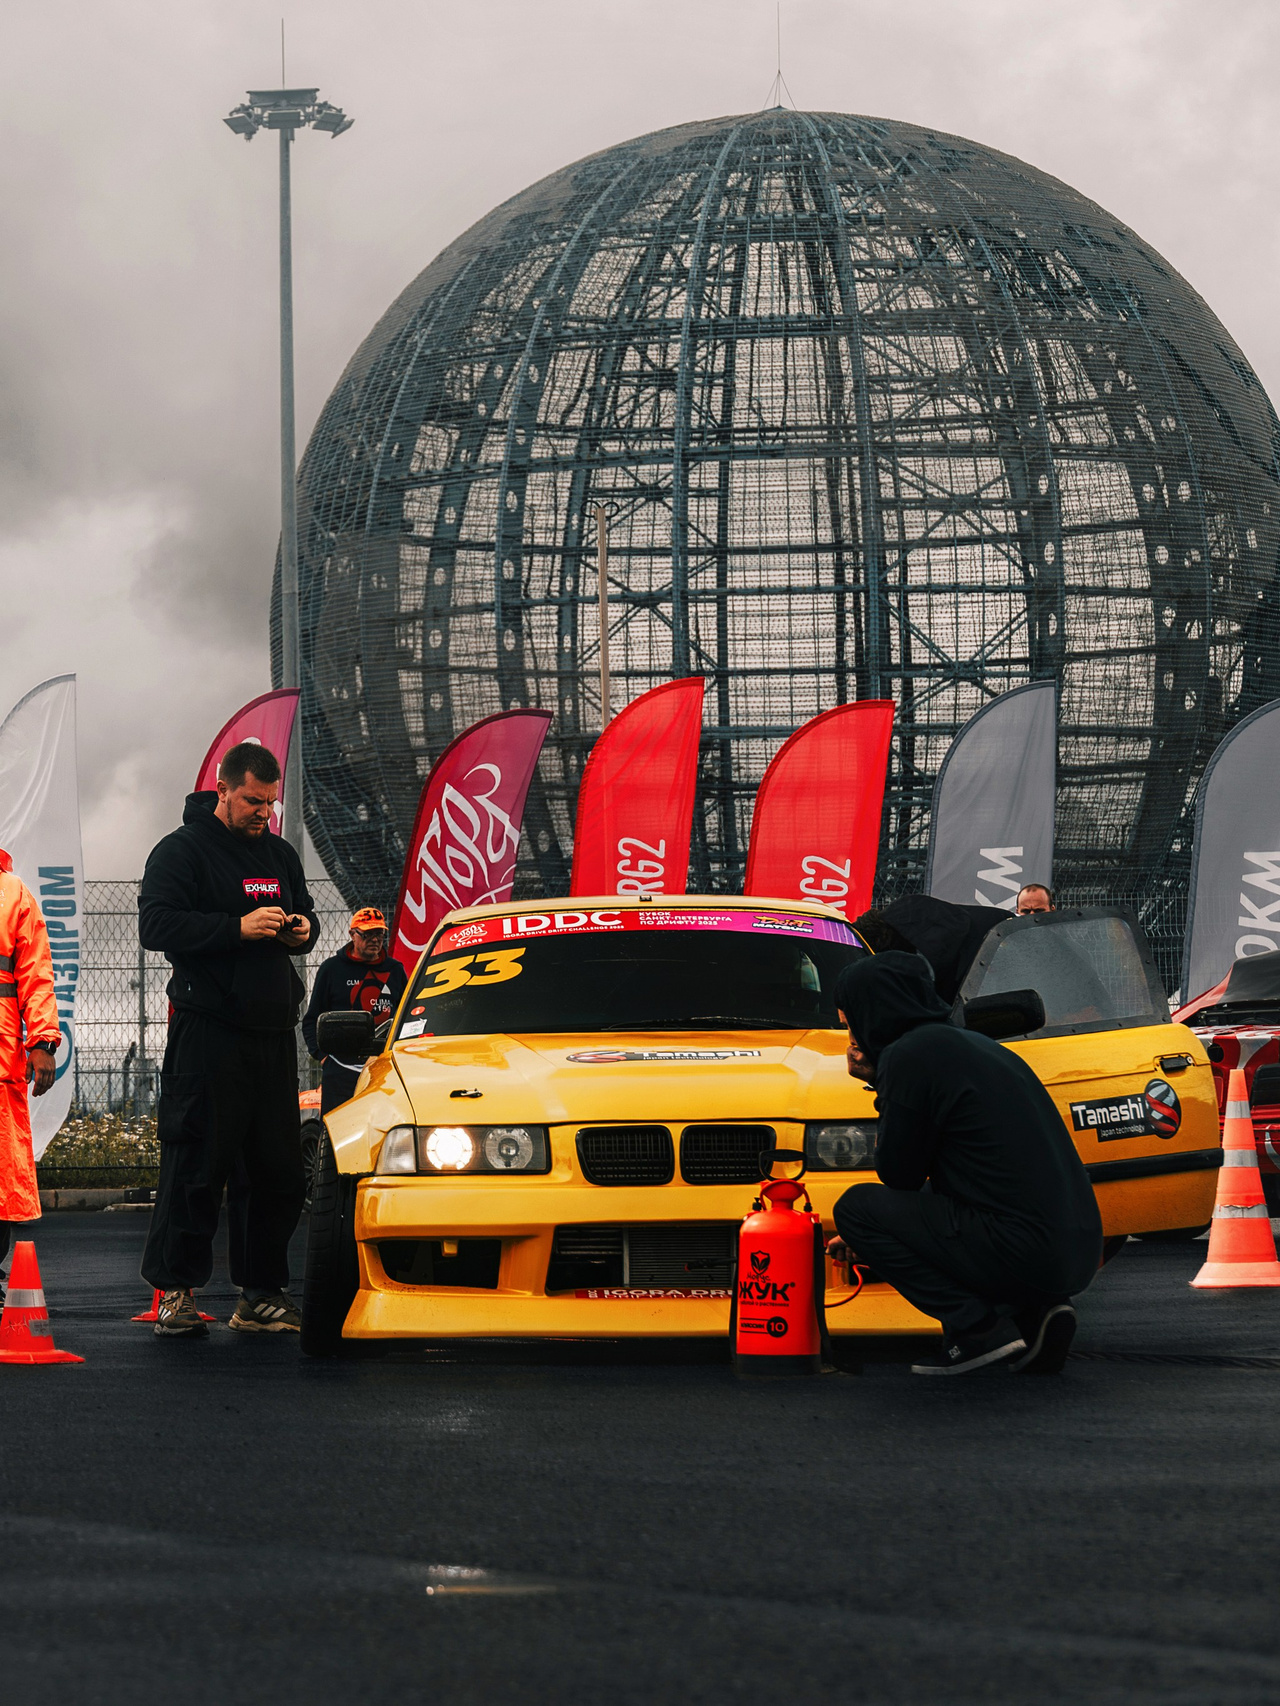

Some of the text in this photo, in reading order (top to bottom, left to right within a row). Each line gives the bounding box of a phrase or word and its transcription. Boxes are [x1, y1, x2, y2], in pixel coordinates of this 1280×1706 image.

[245, 883, 278, 892] EXHAUST
[502, 911, 622, 934] IDDC
[415, 947, 526, 999] 33
[1072, 1097, 1145, 1127] Tamashi
[1116, 1124, 1145, 1134] technology
[739, 1281, 790, 1301] ЖУК
[770, 1321, 786, 1332] 10
